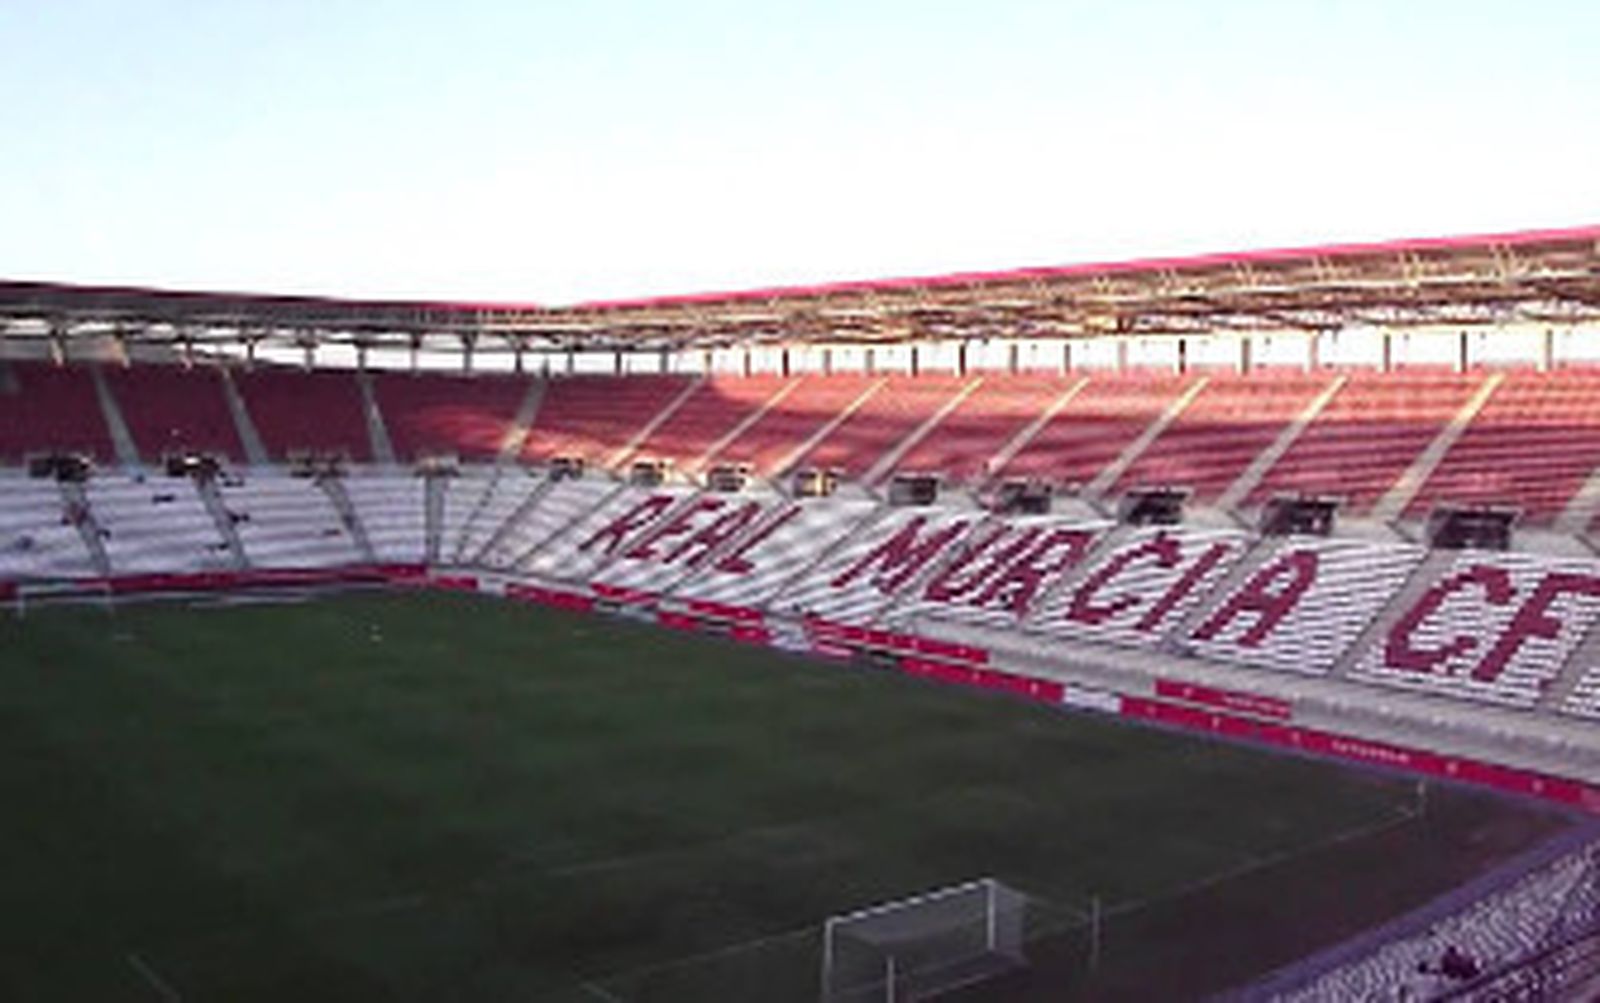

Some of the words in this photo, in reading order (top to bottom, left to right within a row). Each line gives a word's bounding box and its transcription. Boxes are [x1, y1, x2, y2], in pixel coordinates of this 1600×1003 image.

[579, 497, 800, 573] REAL
[830, 516, 1319, 647] MURCIA
[1385, 564, 1600, 682] CF
